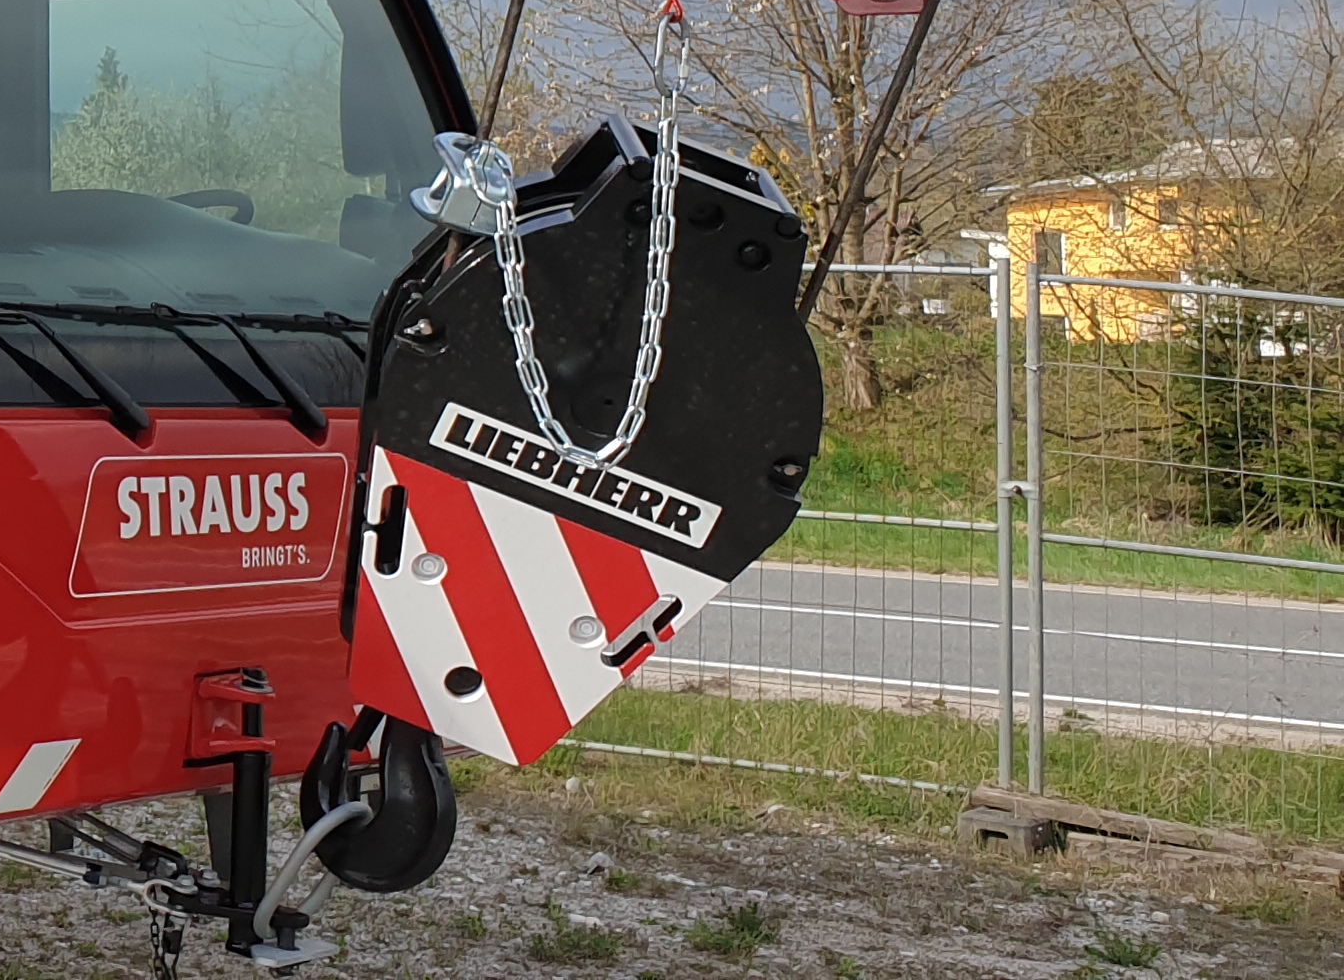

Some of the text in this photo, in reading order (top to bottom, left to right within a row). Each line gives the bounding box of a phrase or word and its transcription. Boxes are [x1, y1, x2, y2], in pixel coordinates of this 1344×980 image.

[117, 472, 310, 539] STRAUSS
[443, 412, 701, 538] LIEBHERR
[241, 544, 311, 569] BRINGT'S.
